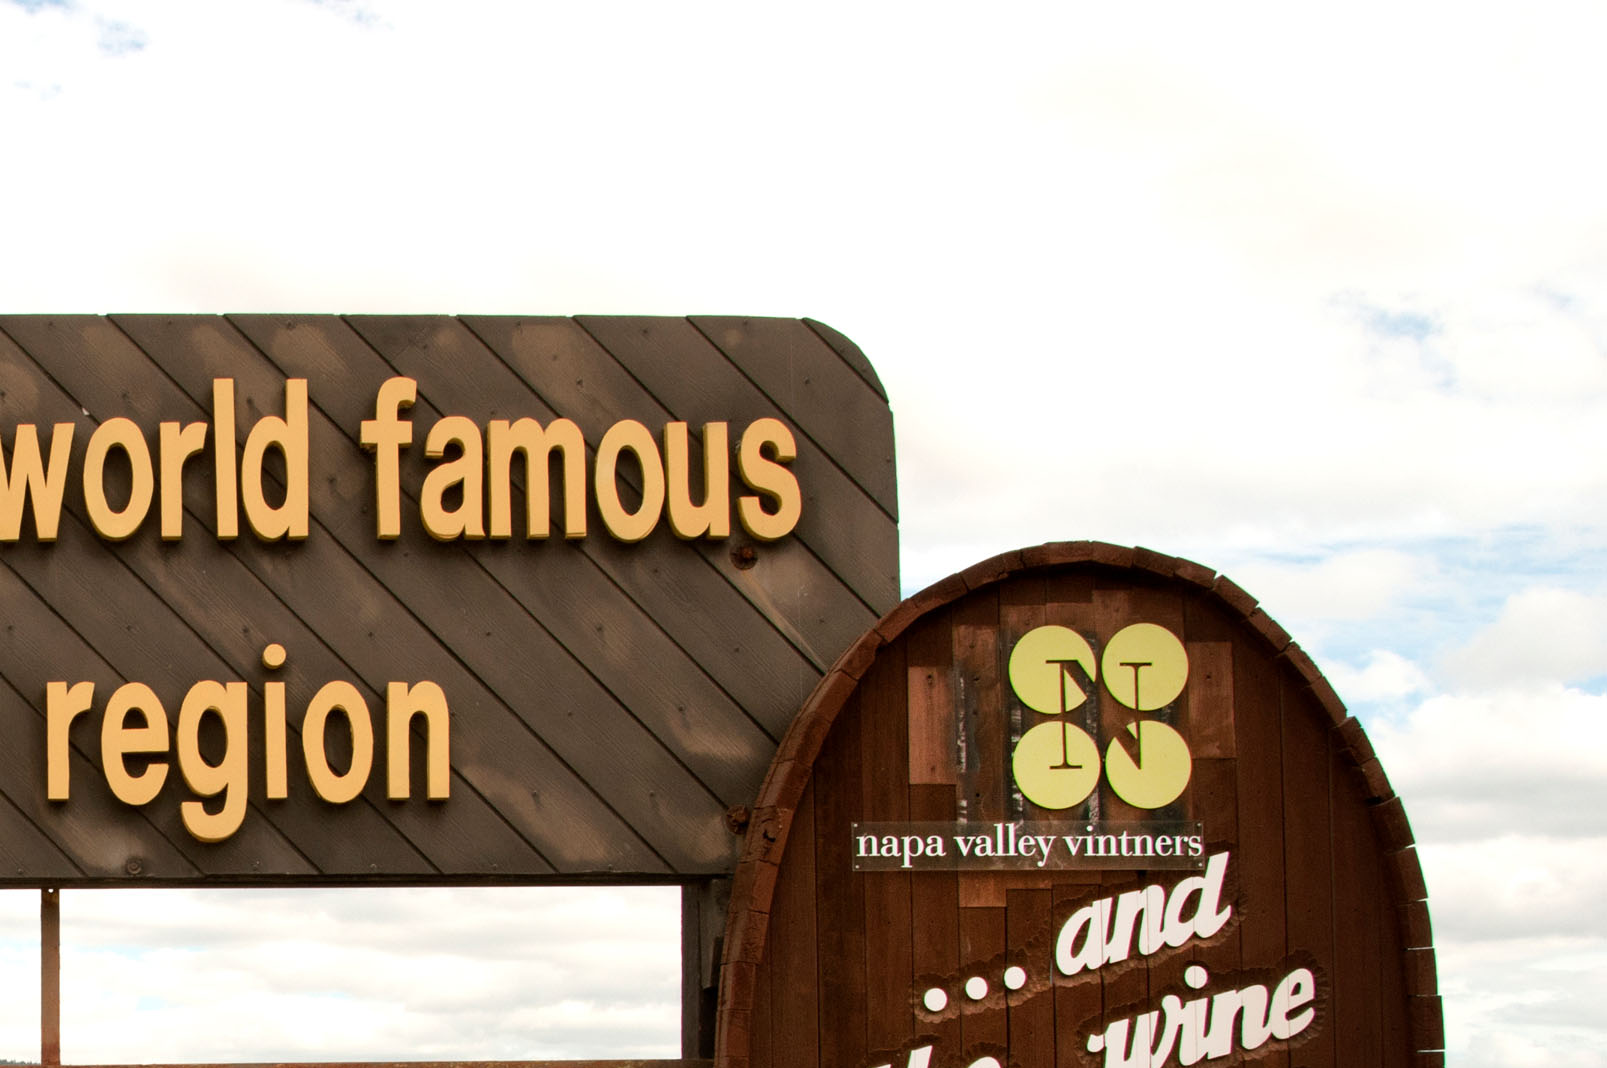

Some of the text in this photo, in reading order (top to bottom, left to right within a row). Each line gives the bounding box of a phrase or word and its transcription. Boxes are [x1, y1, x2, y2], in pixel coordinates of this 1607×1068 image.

[360, 376, 803, 542] famous
[46, 643, 451, 841] region
[857, 822, 1204, 868] napa valley vintners
